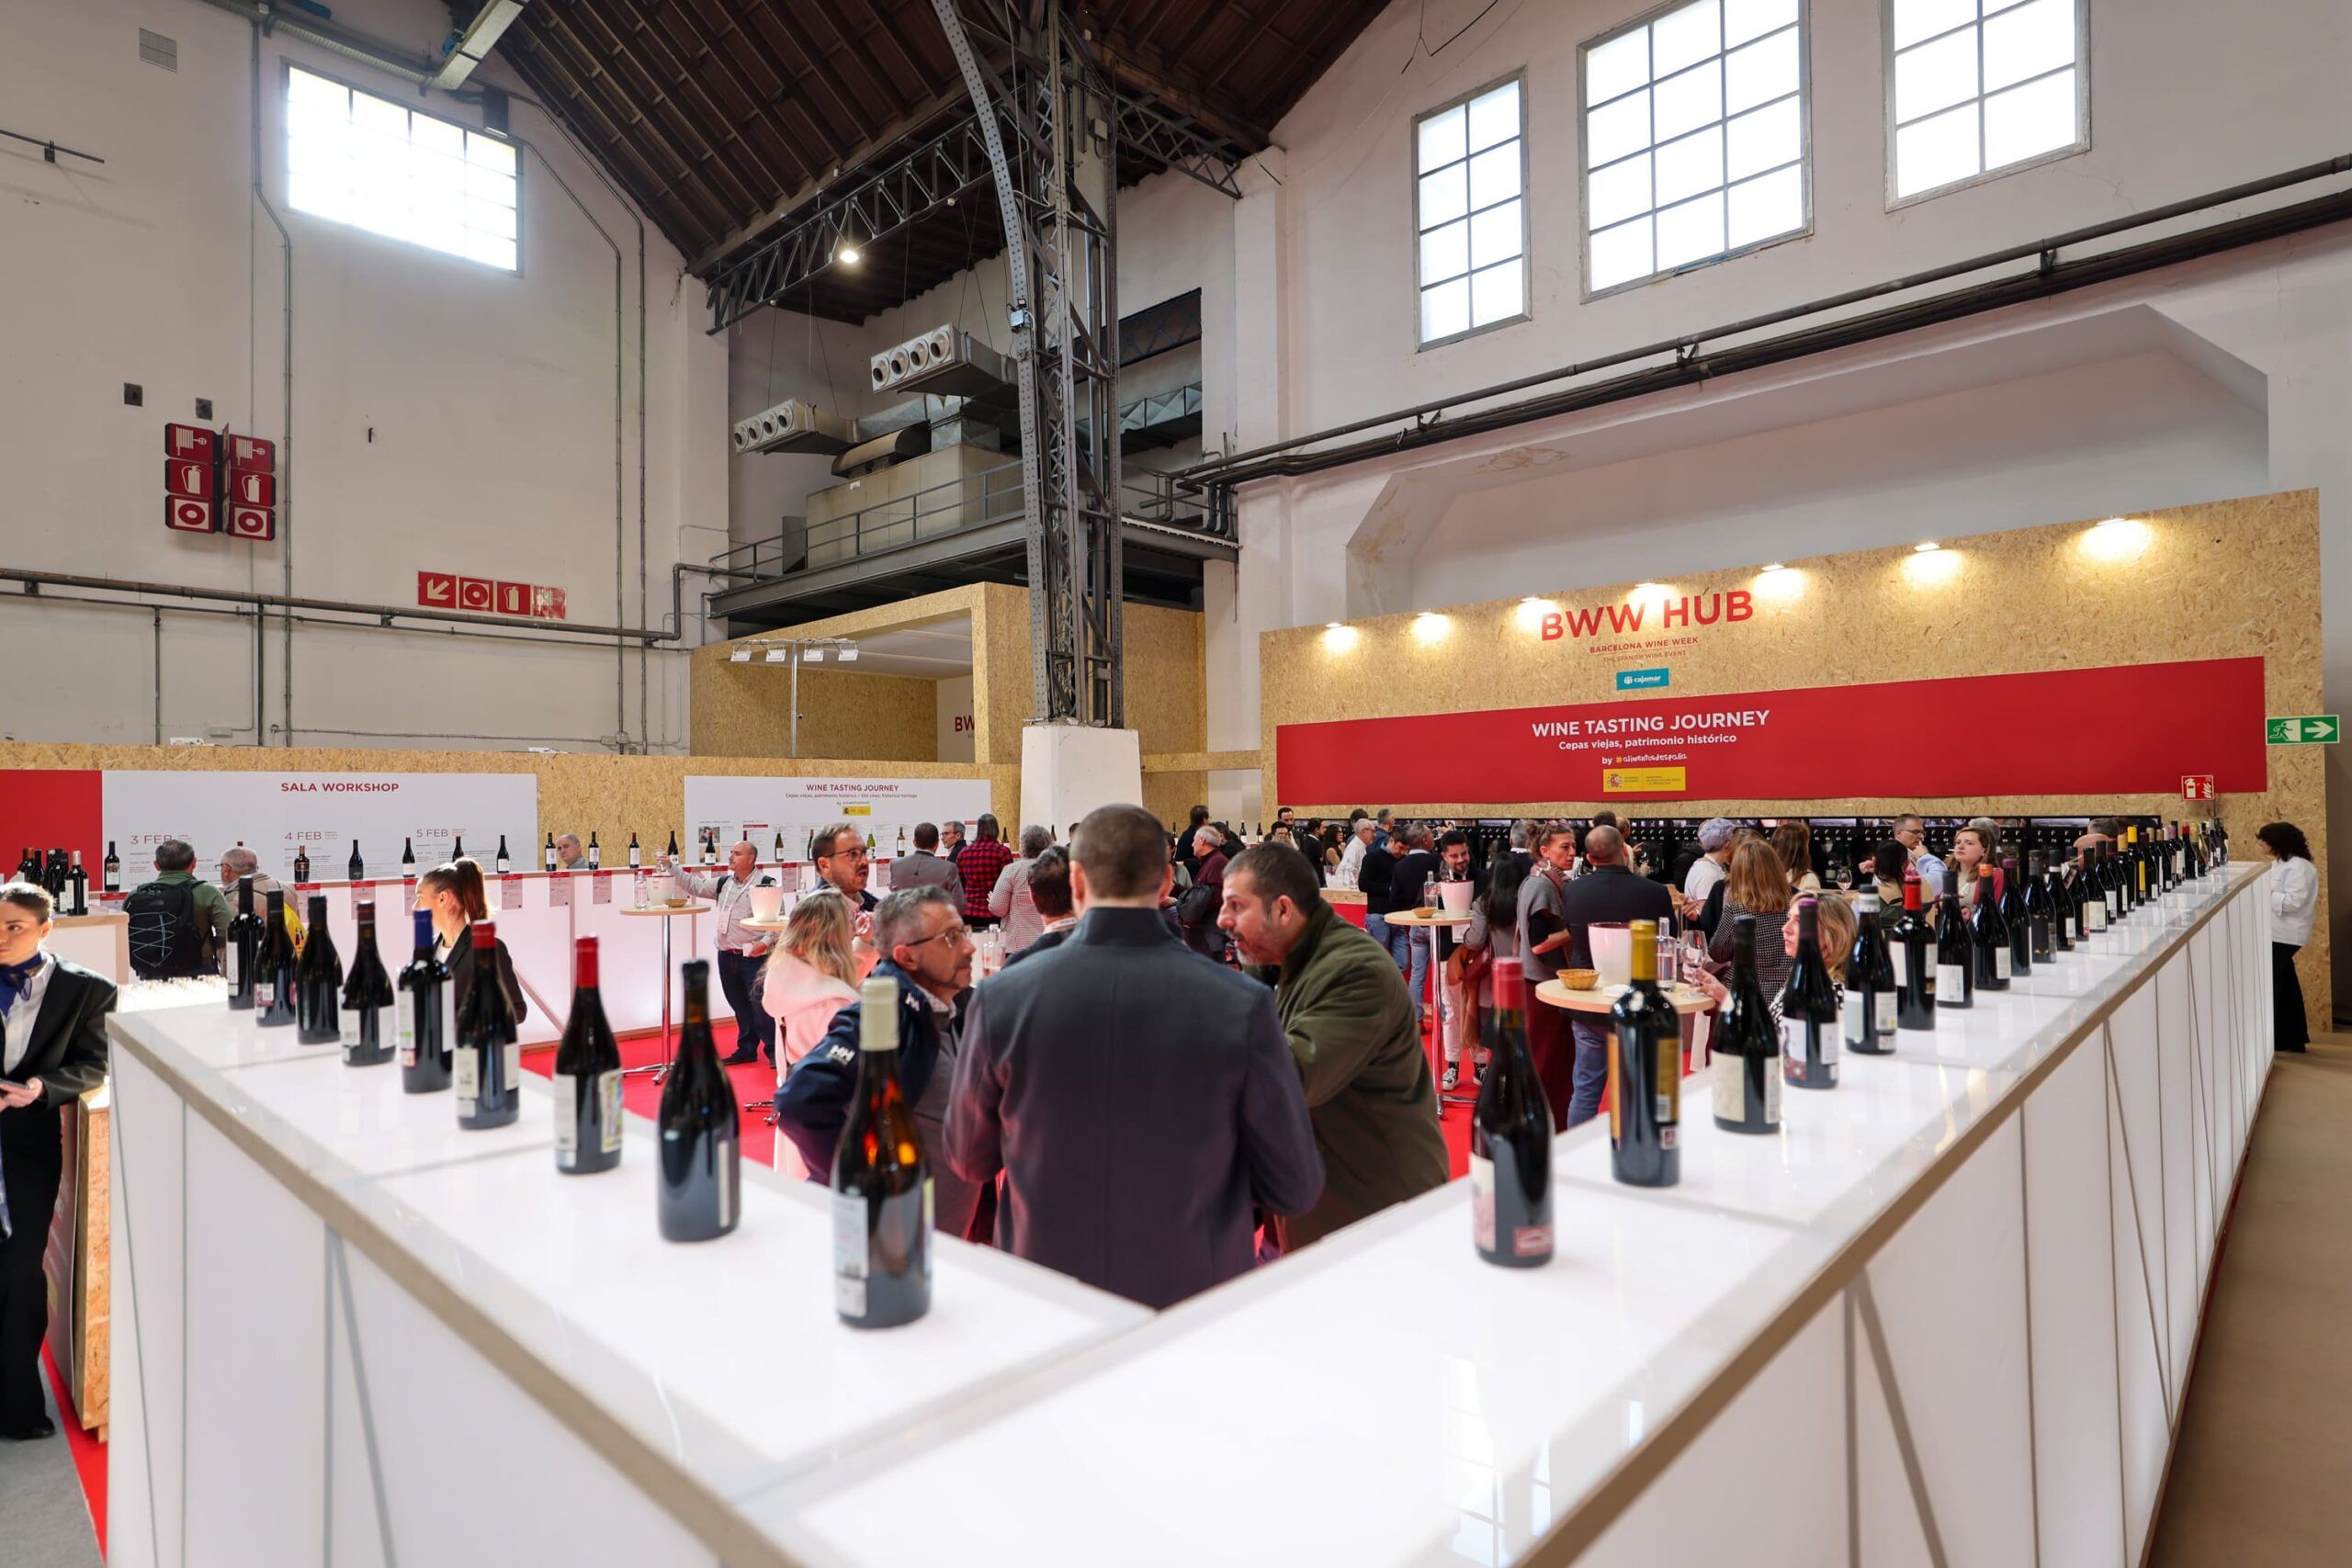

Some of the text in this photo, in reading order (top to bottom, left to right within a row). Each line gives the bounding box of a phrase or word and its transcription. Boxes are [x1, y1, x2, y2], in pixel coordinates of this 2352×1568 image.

[1542, 590, 1753, 641] BWW HUB
[1589, 636, 1699, 654] BARCELONA WINE WEEK
[1634, 674, 1661, 684] cajamar
[1532, 709, 1770, 738] WINE TASTING JOURNEY
[1559, 733, 1736, 750] Cepas viejas, patrimonio histórico
[1601, 756, 1612, 765] by
[281, 783, 399, 792] SALA WORKSHOP
[285, 831, 292, 840] 4
[298, 831, 322, 840] FEB
[416, 829, 423, 838] 5
[426, 829, 448, 838] FEB
[130, 835, 139, 844] 3
